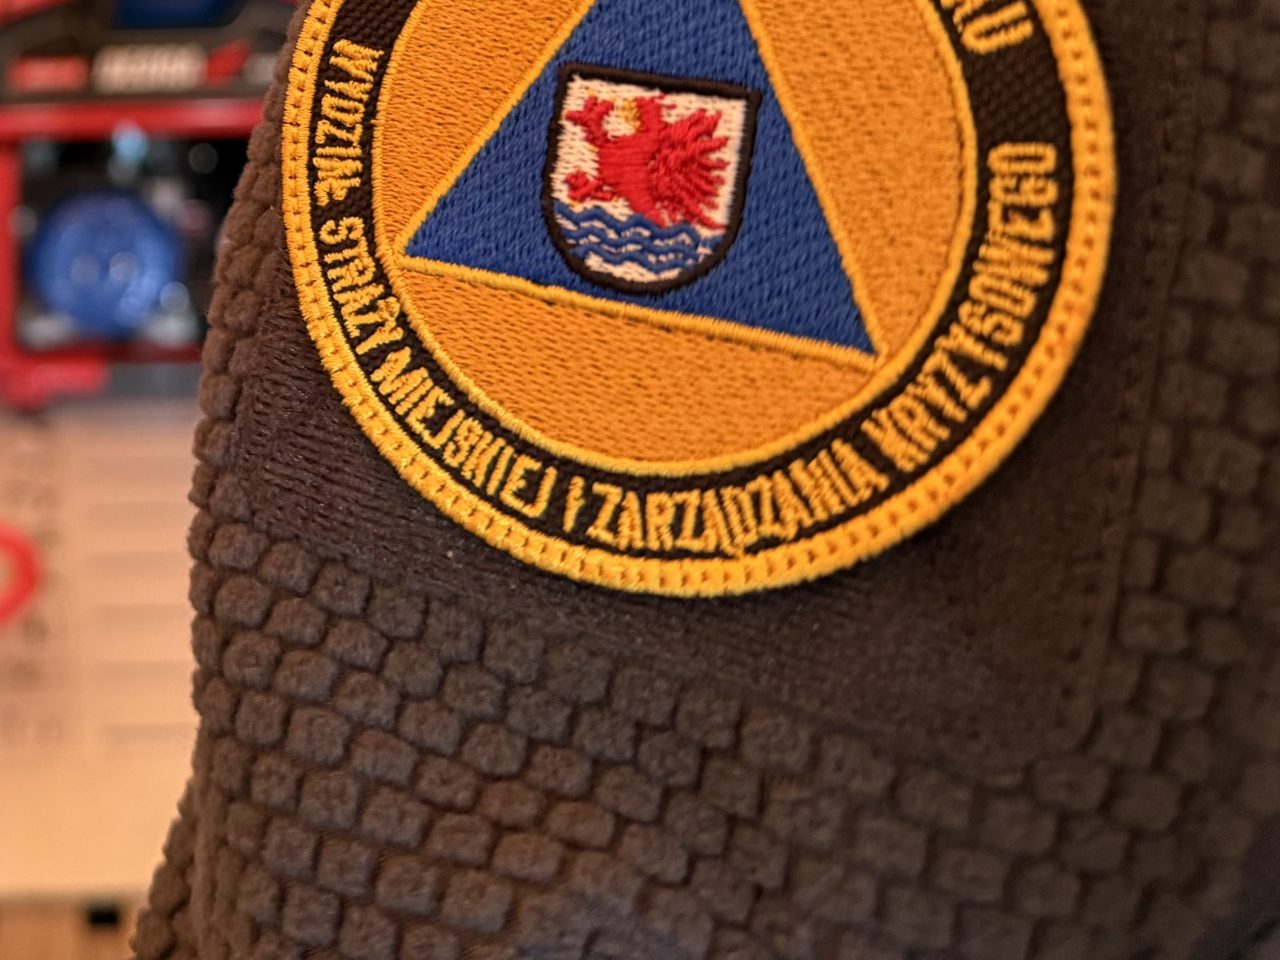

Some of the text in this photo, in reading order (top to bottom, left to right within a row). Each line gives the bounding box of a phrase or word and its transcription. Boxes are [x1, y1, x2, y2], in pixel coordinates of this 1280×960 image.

[313, 39, 1058, 557] WYDZIAŁ STRAŻY MIEJSKIEJ I ZARZĄDZANIA KRYZYSOWEGO
